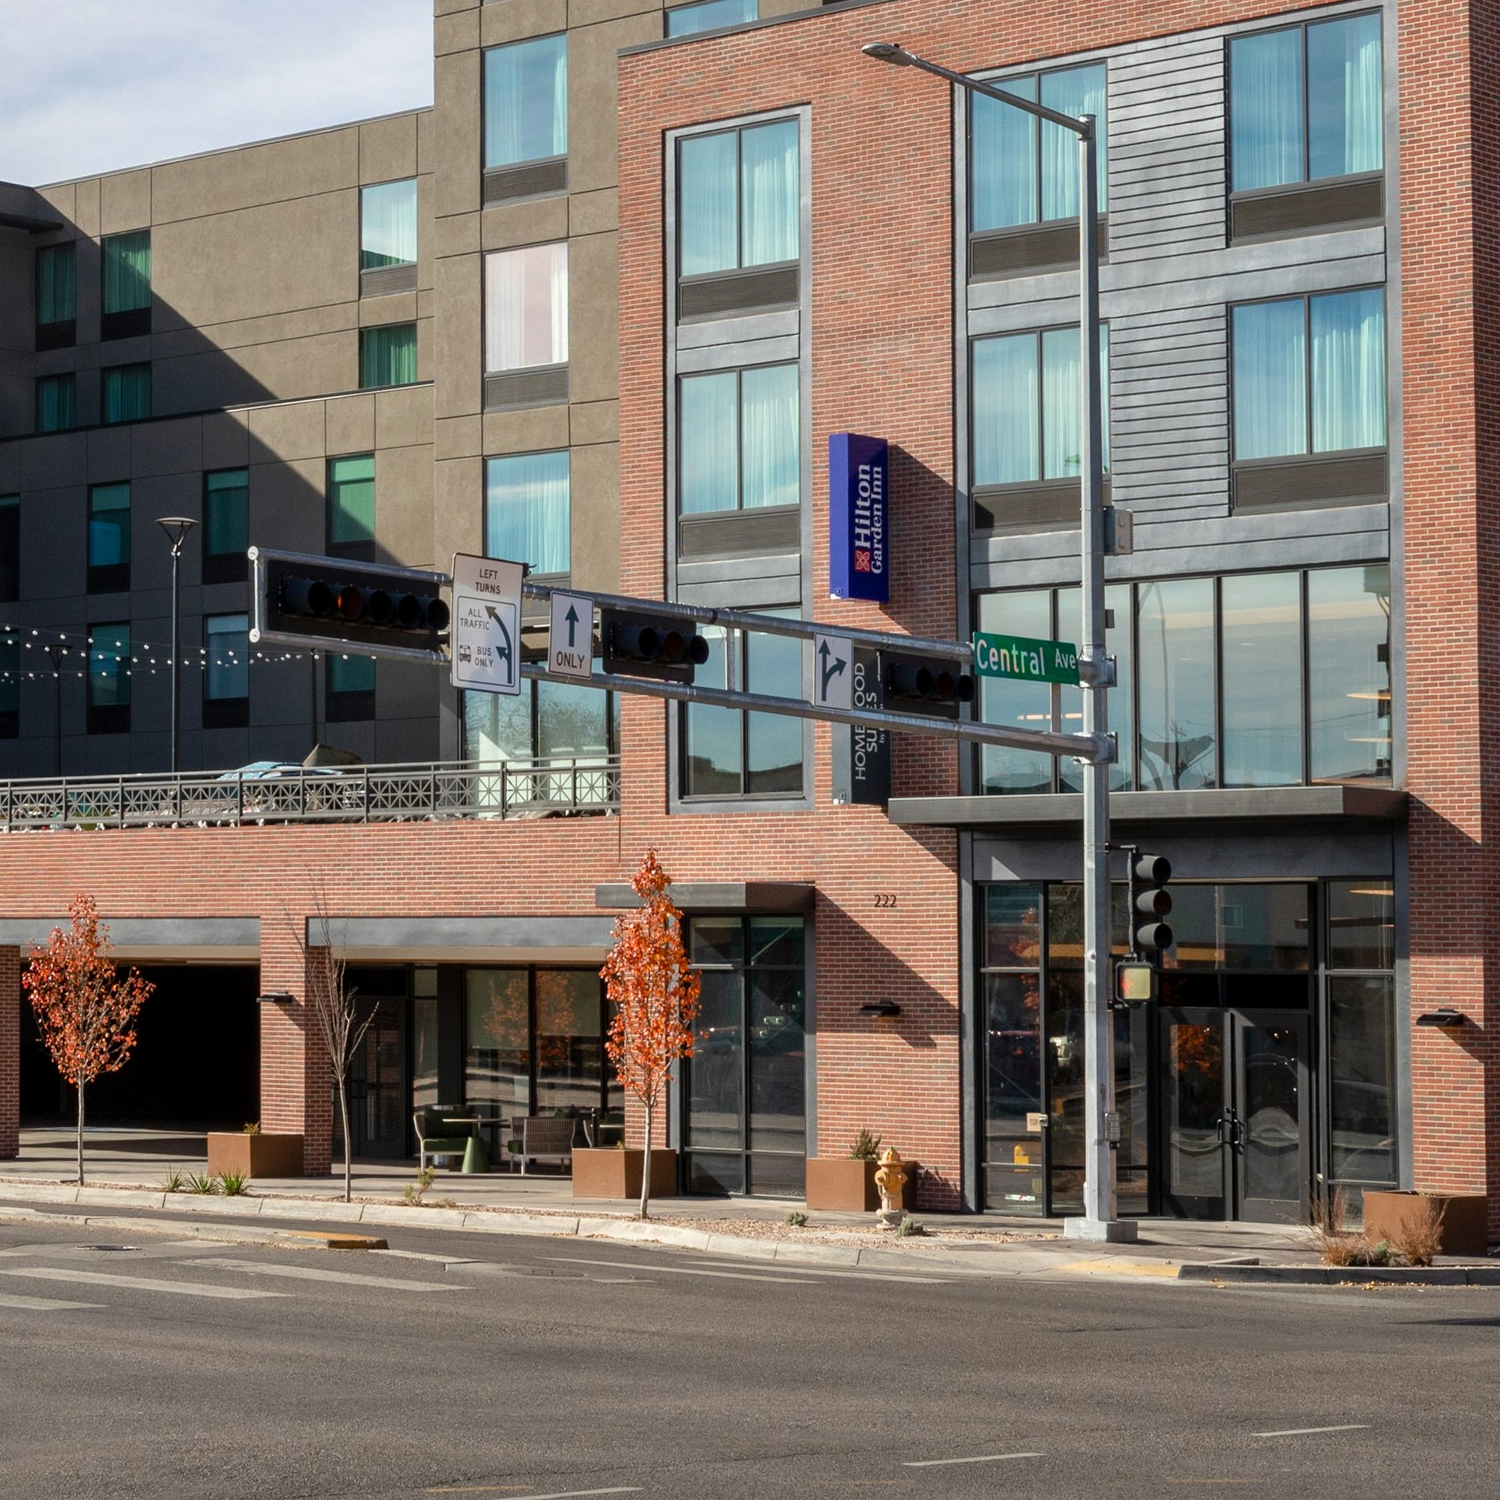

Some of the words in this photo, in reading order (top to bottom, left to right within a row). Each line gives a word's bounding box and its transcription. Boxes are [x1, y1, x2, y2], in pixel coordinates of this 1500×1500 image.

[871, 466, 882, 500] Inn
[855, 464, 871, 549] Hilton
[871, 503, 882, 574] Garden
[479, 568, 498, 580] LEFT
[475, 581, 501, 595] TURNS
[468, 608, 482, 618] ALL
[460, 617, 490, 631] TRAFFIC
[477, 646, 492, 656] BUS
[976, 638, 1045, 676] Central
[1055, 647, 1076, 669] Ave
[474, 657, 494, 668] ONLY
[556, 651, 585, 669] ONLY
[854, 662, 866, 780] HOMEOOD
[874, 894, 897, 908] 222
